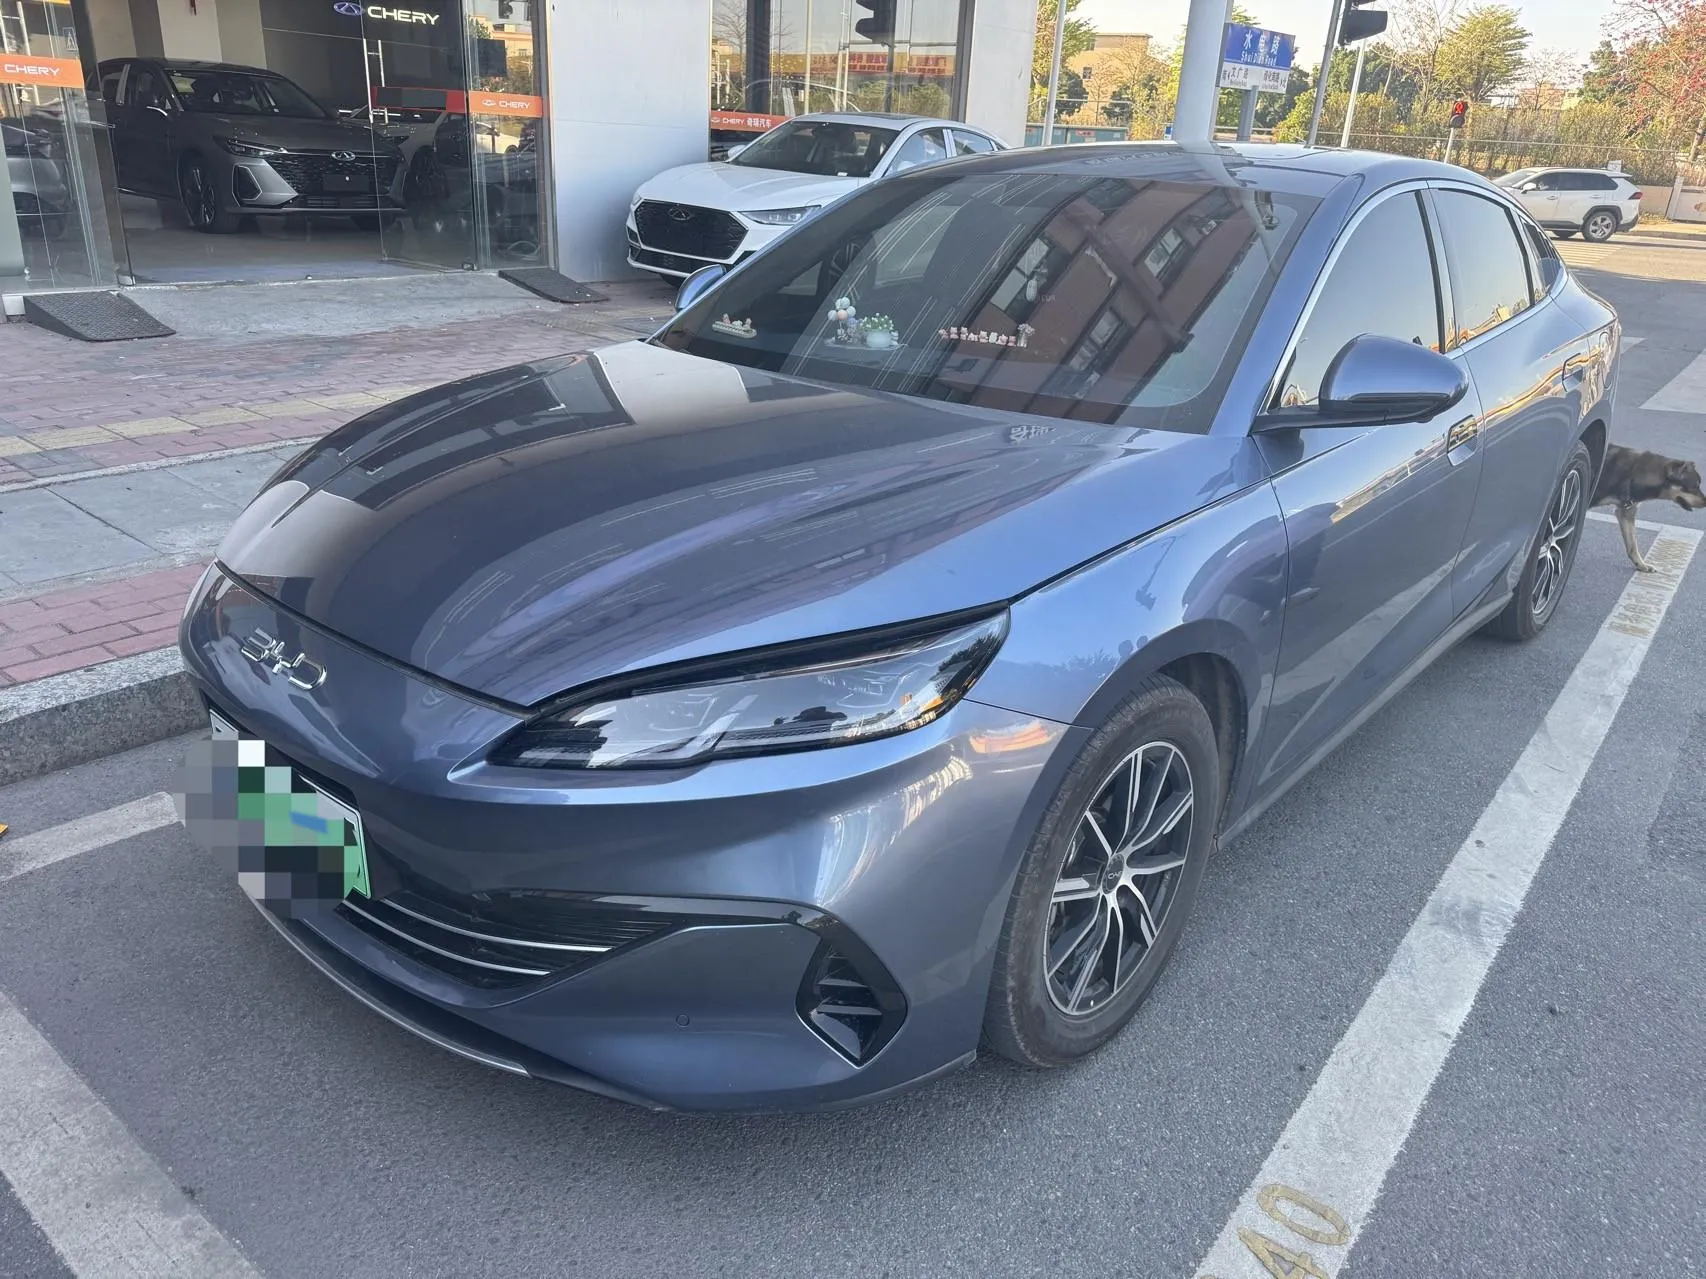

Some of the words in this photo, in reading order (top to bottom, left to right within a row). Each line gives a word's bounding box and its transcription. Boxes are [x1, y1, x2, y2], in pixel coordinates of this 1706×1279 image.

[367, 5, 440, 25] CHERY
[4, 63, 61, 76] CHERY
[499, 100, 531, 109] CHERY
[722, 117, 745, 125] CHERY
[241, 628, 327, 692] BYD
